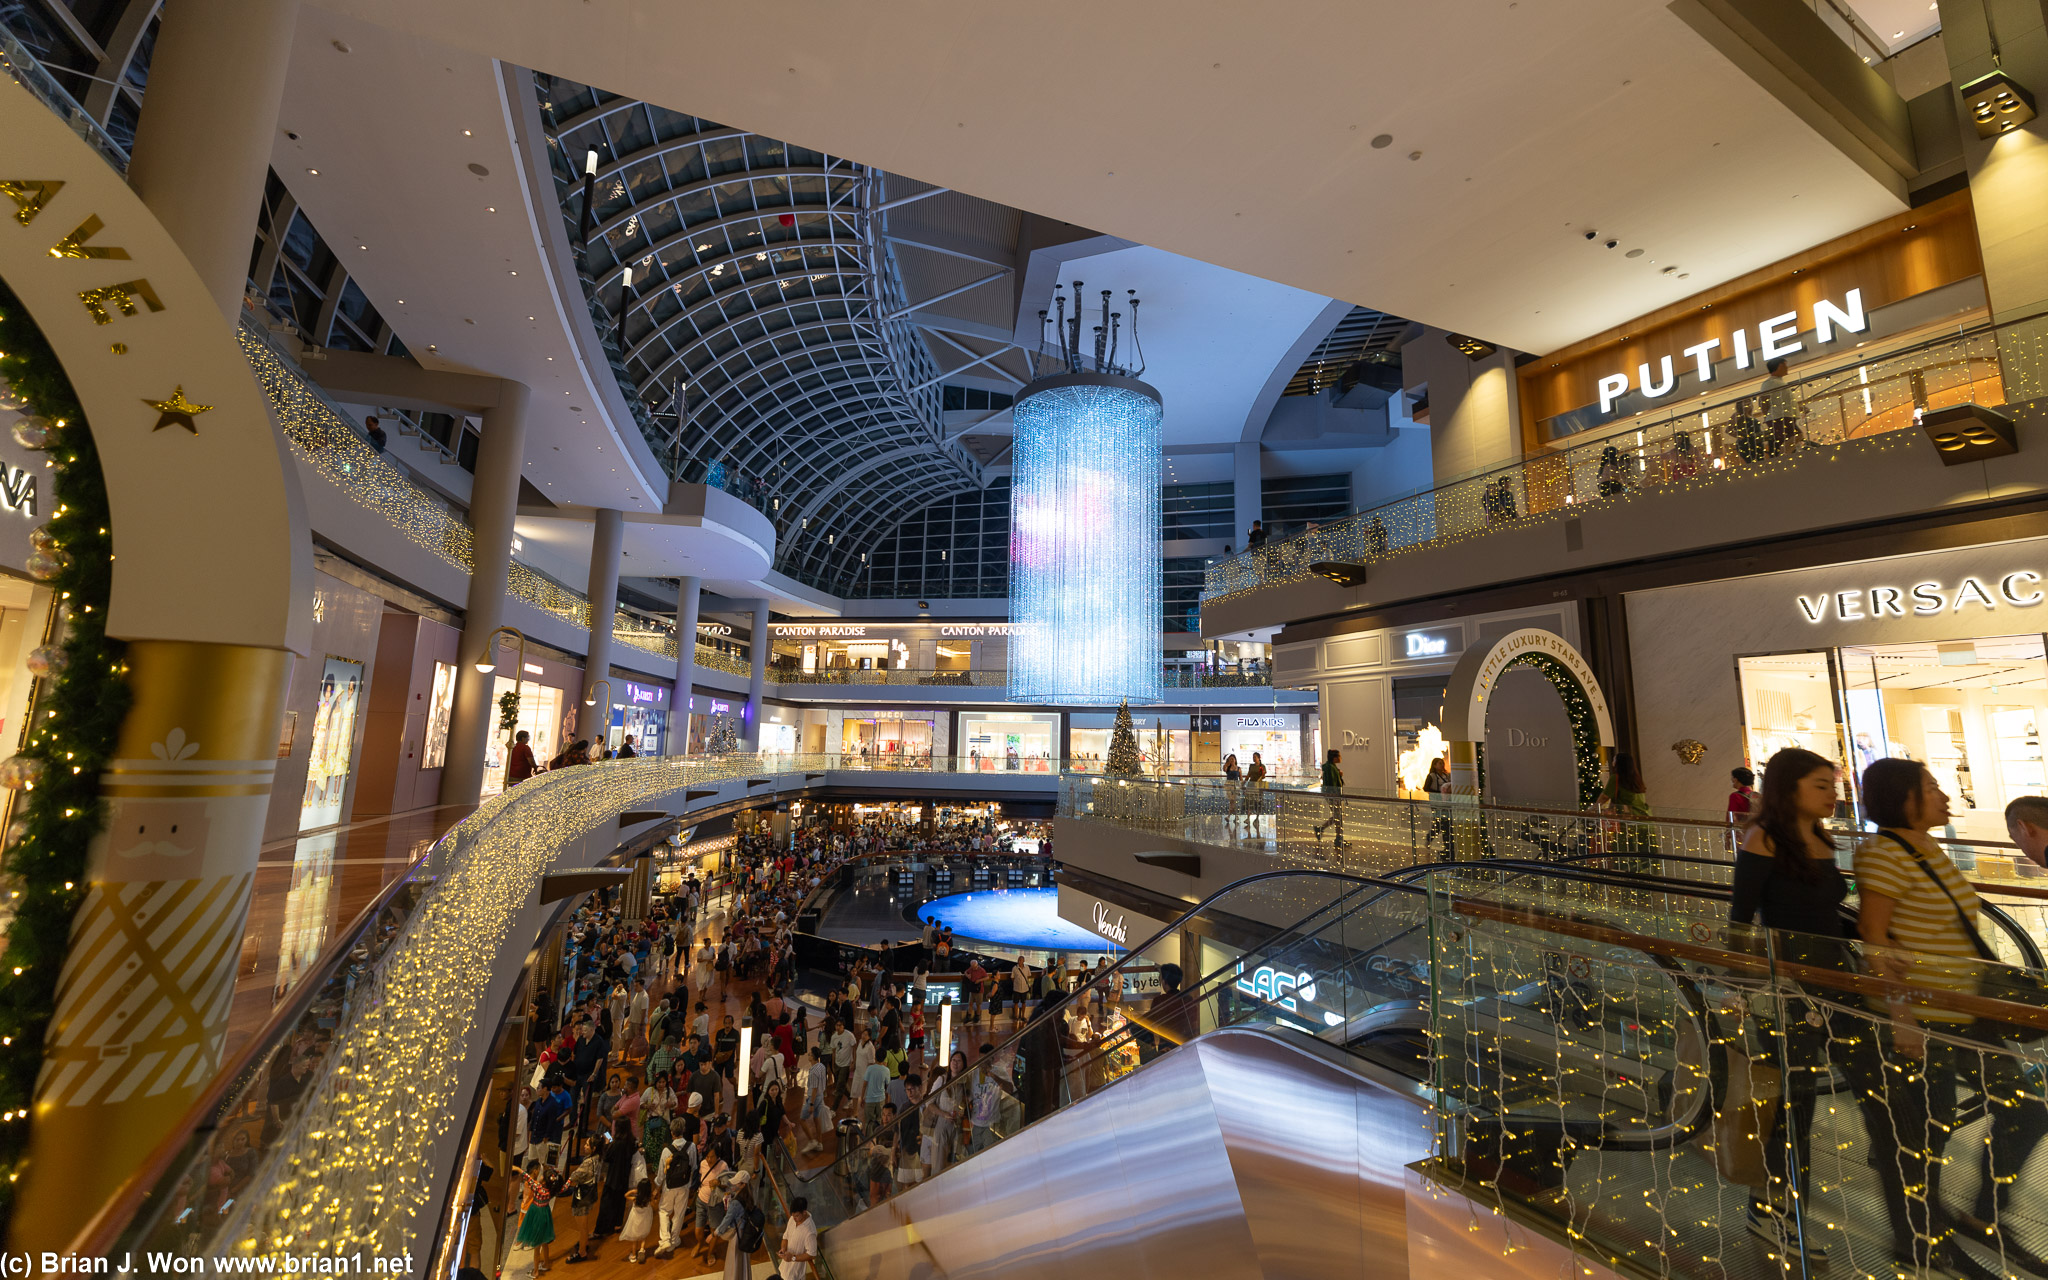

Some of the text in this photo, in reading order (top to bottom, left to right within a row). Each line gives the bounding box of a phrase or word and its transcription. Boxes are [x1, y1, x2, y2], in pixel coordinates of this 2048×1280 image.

[1598, 288, 1866, 414] PUTIEN
[1798, 571, 2046, 622] VERSAC
[775, 627, 866, 636] CANTON PARADISE
[941, 626, 984, 636] CANTON
[1406, 633, 1447, 657] Dior
[1480, 635, 1597, 699] LITTLE LUXURY STARS AVE.
[1237, 718, 1285, 727] FILA KIDS
[1342, 729, 1371, 749] Dior
[1507, 728, 1550, 747] Dior
[1093, 901, 1127, 944] Venchi
[1133, 977, 1147, 990] by
